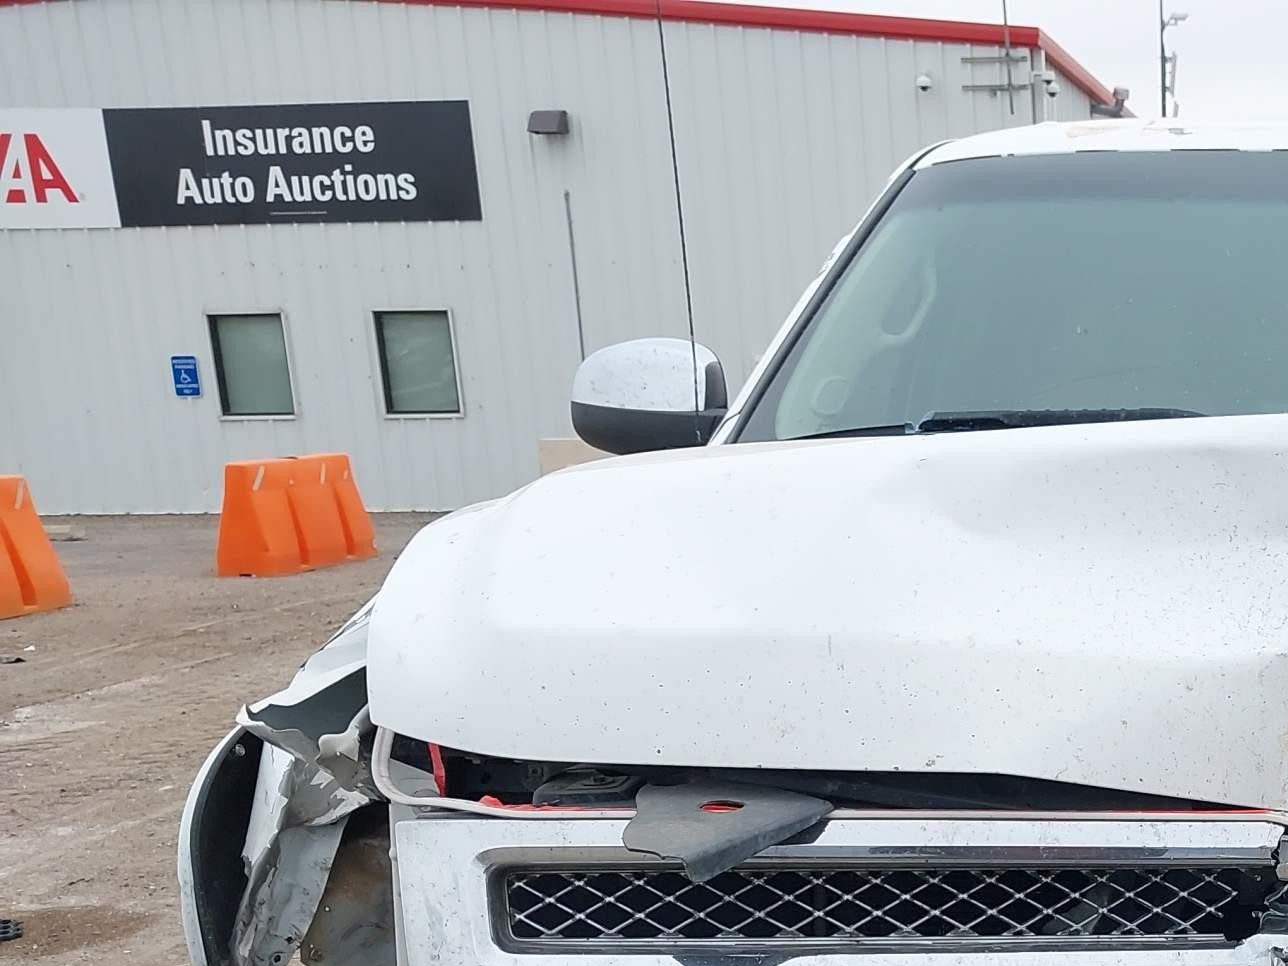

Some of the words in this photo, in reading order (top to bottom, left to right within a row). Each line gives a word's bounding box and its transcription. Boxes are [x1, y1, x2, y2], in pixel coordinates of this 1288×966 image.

[201, 119, 375, 157] Insurance
[176, 168, 255, 205] Auto
[265, 165, 417, 203] Auctions
